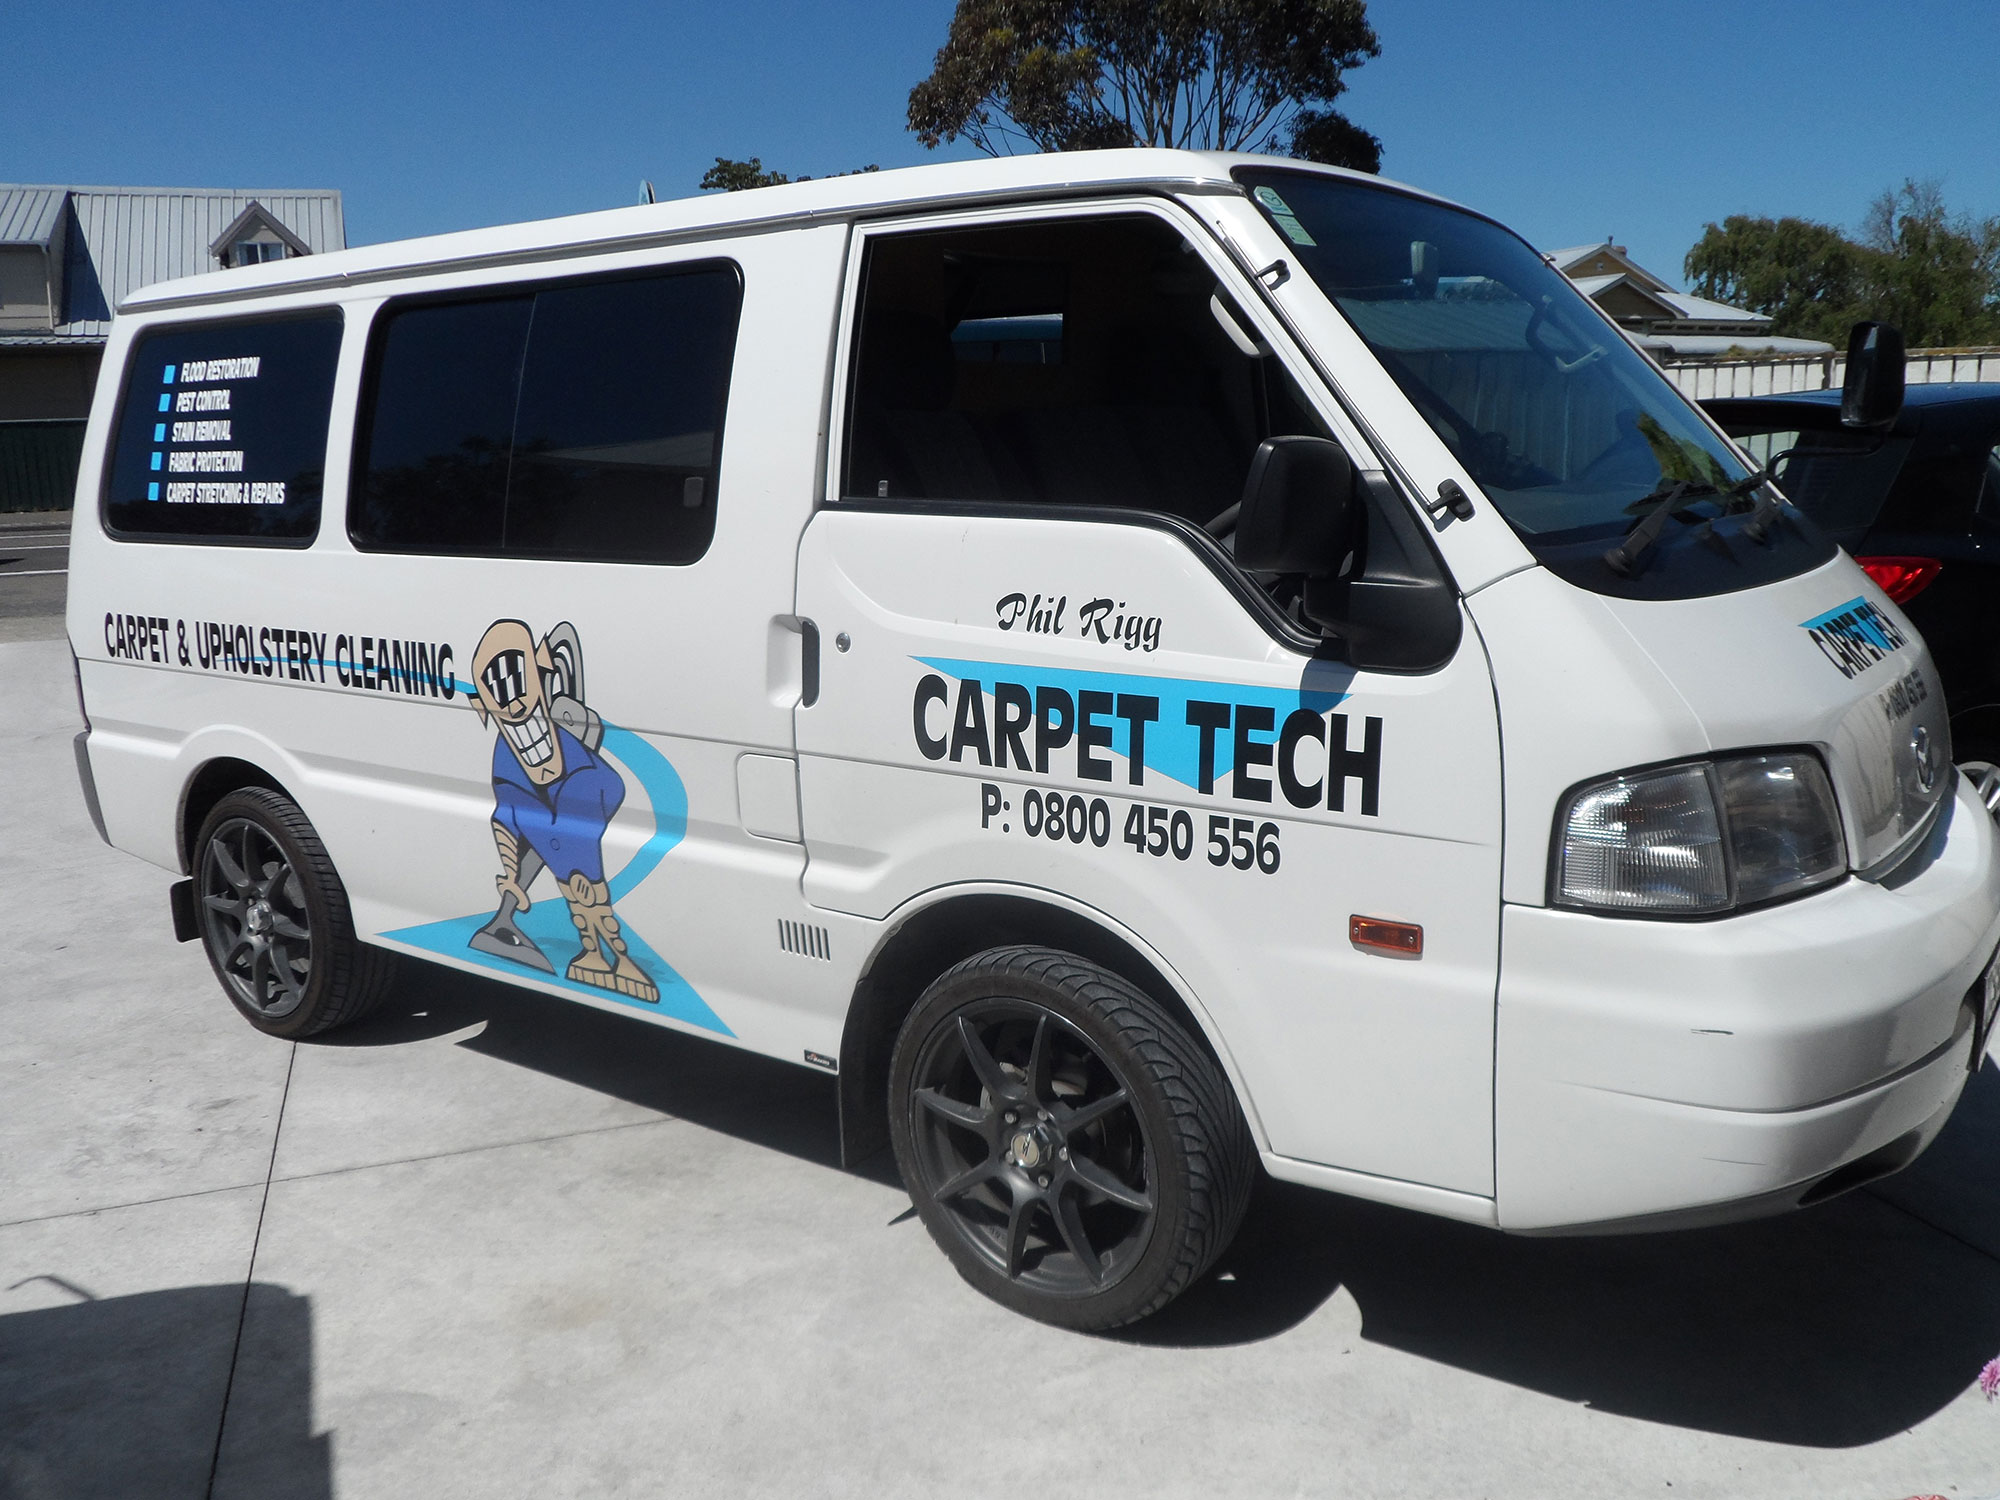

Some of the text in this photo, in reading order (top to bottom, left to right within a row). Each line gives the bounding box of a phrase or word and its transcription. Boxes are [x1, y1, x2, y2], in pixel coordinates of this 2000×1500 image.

[181, 357, 260, 382] FLOOD RESTORATION
[176, 389, 230, 412] PEST CONTROL
[172, 420, 231, 442] STAIN REMOVAL
[169, 451, 243, 472] FABRIC PROTECTION
[166, 482, 285, 504] CARPET STRETCHING & REPAIRS
[995, 593, 1162, 652] Phil Rigg
[104, 612, 455, 700] CARPET & UPHOLSTERY CLEANING
[1808, 612, 1887, 680] CARPET
[913, 674, 1384, 817] CARPET TECH
[981, 782, 1281, 874] P: 0800 450 556
